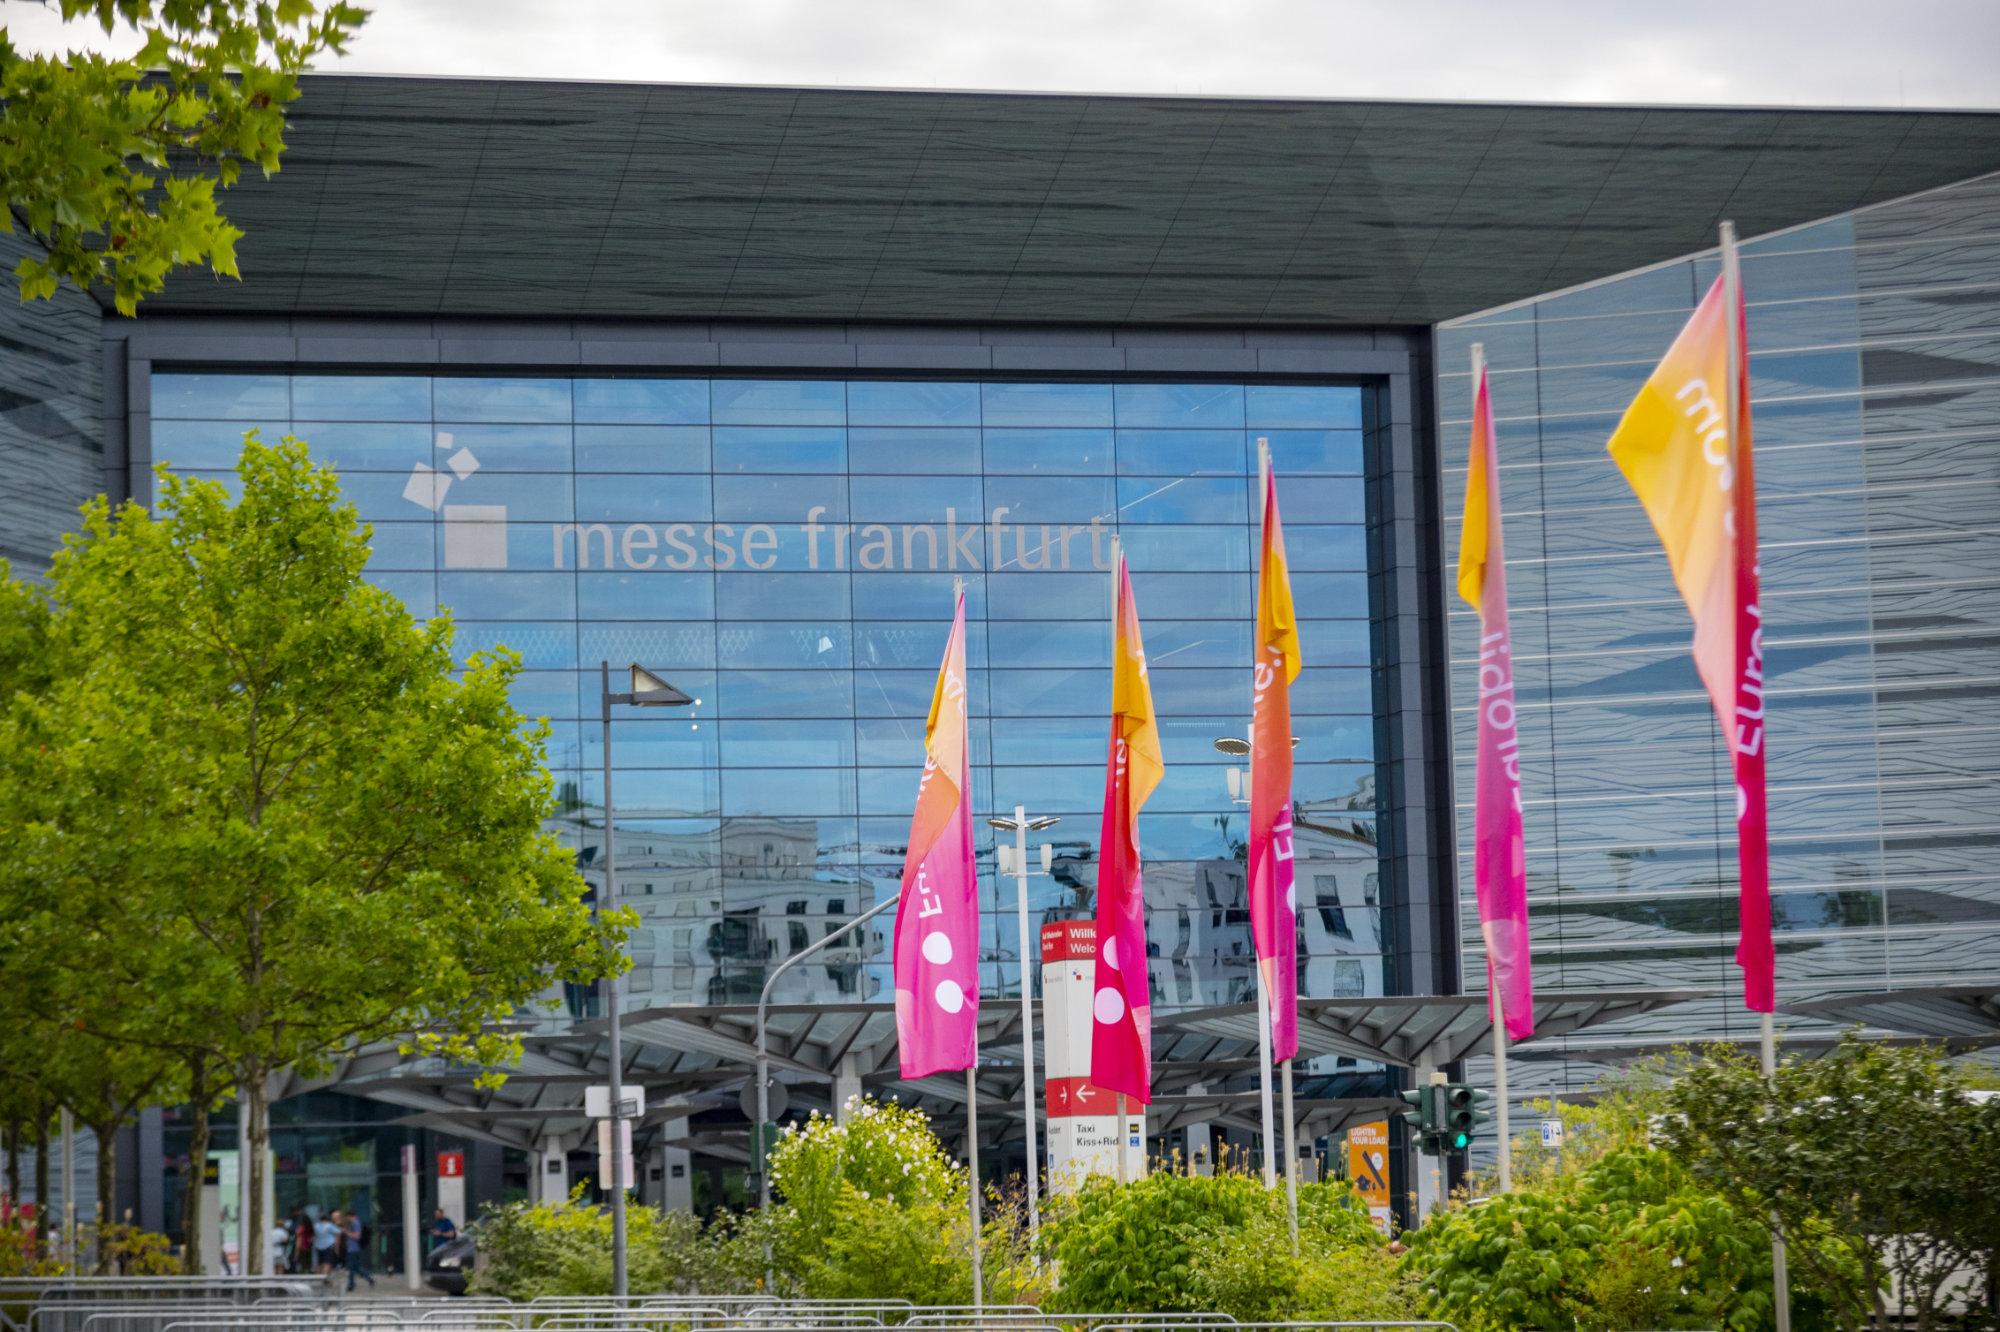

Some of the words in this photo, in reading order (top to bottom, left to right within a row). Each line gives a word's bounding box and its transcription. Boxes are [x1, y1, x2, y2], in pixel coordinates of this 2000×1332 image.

[552, 522, 778, 570] messe
[801, 506, 1109, 570] frankfurt
[1076, 1123, 1095, 1133] Taxi
[1350, 1127, 1376, 1136] LIGHTEN
[1076, 1137, 1119, 1146] Kiss+Rid
[1351, 1136, 1368, 1144] YOUR
